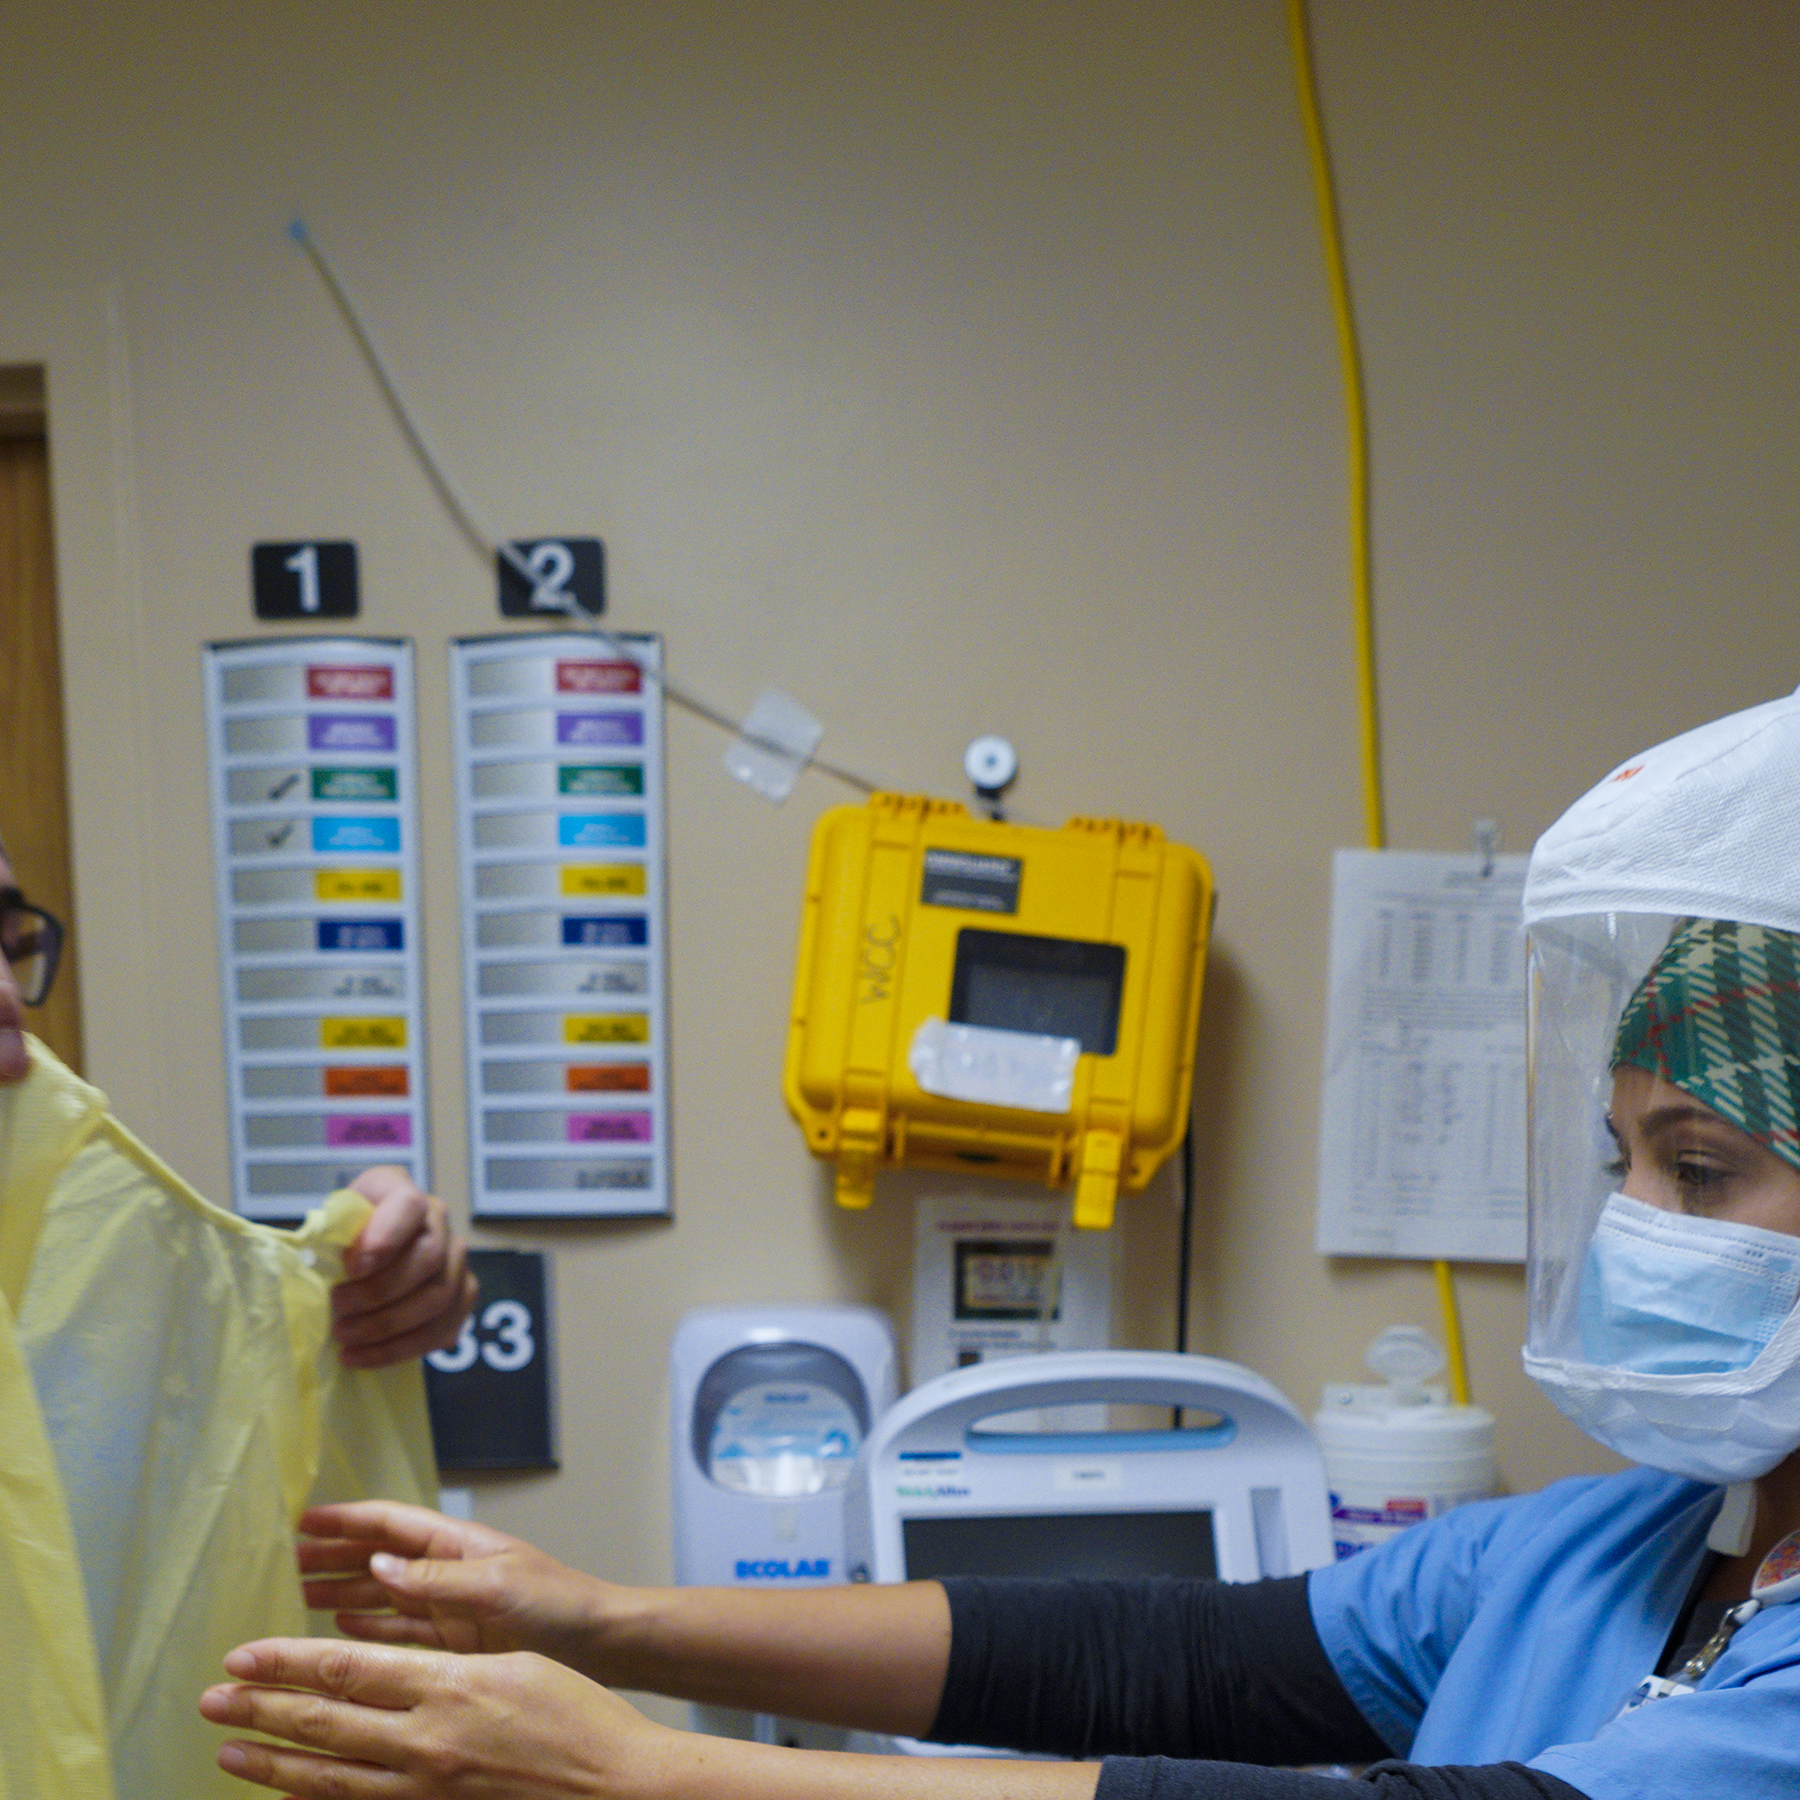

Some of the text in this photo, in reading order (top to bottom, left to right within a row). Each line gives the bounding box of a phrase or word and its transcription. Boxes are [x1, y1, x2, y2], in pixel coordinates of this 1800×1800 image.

[286, 546, 320, 611] 1
[529, 543, 576, 610] 2
[734, 1558, 831, 1579] ECOLAB
